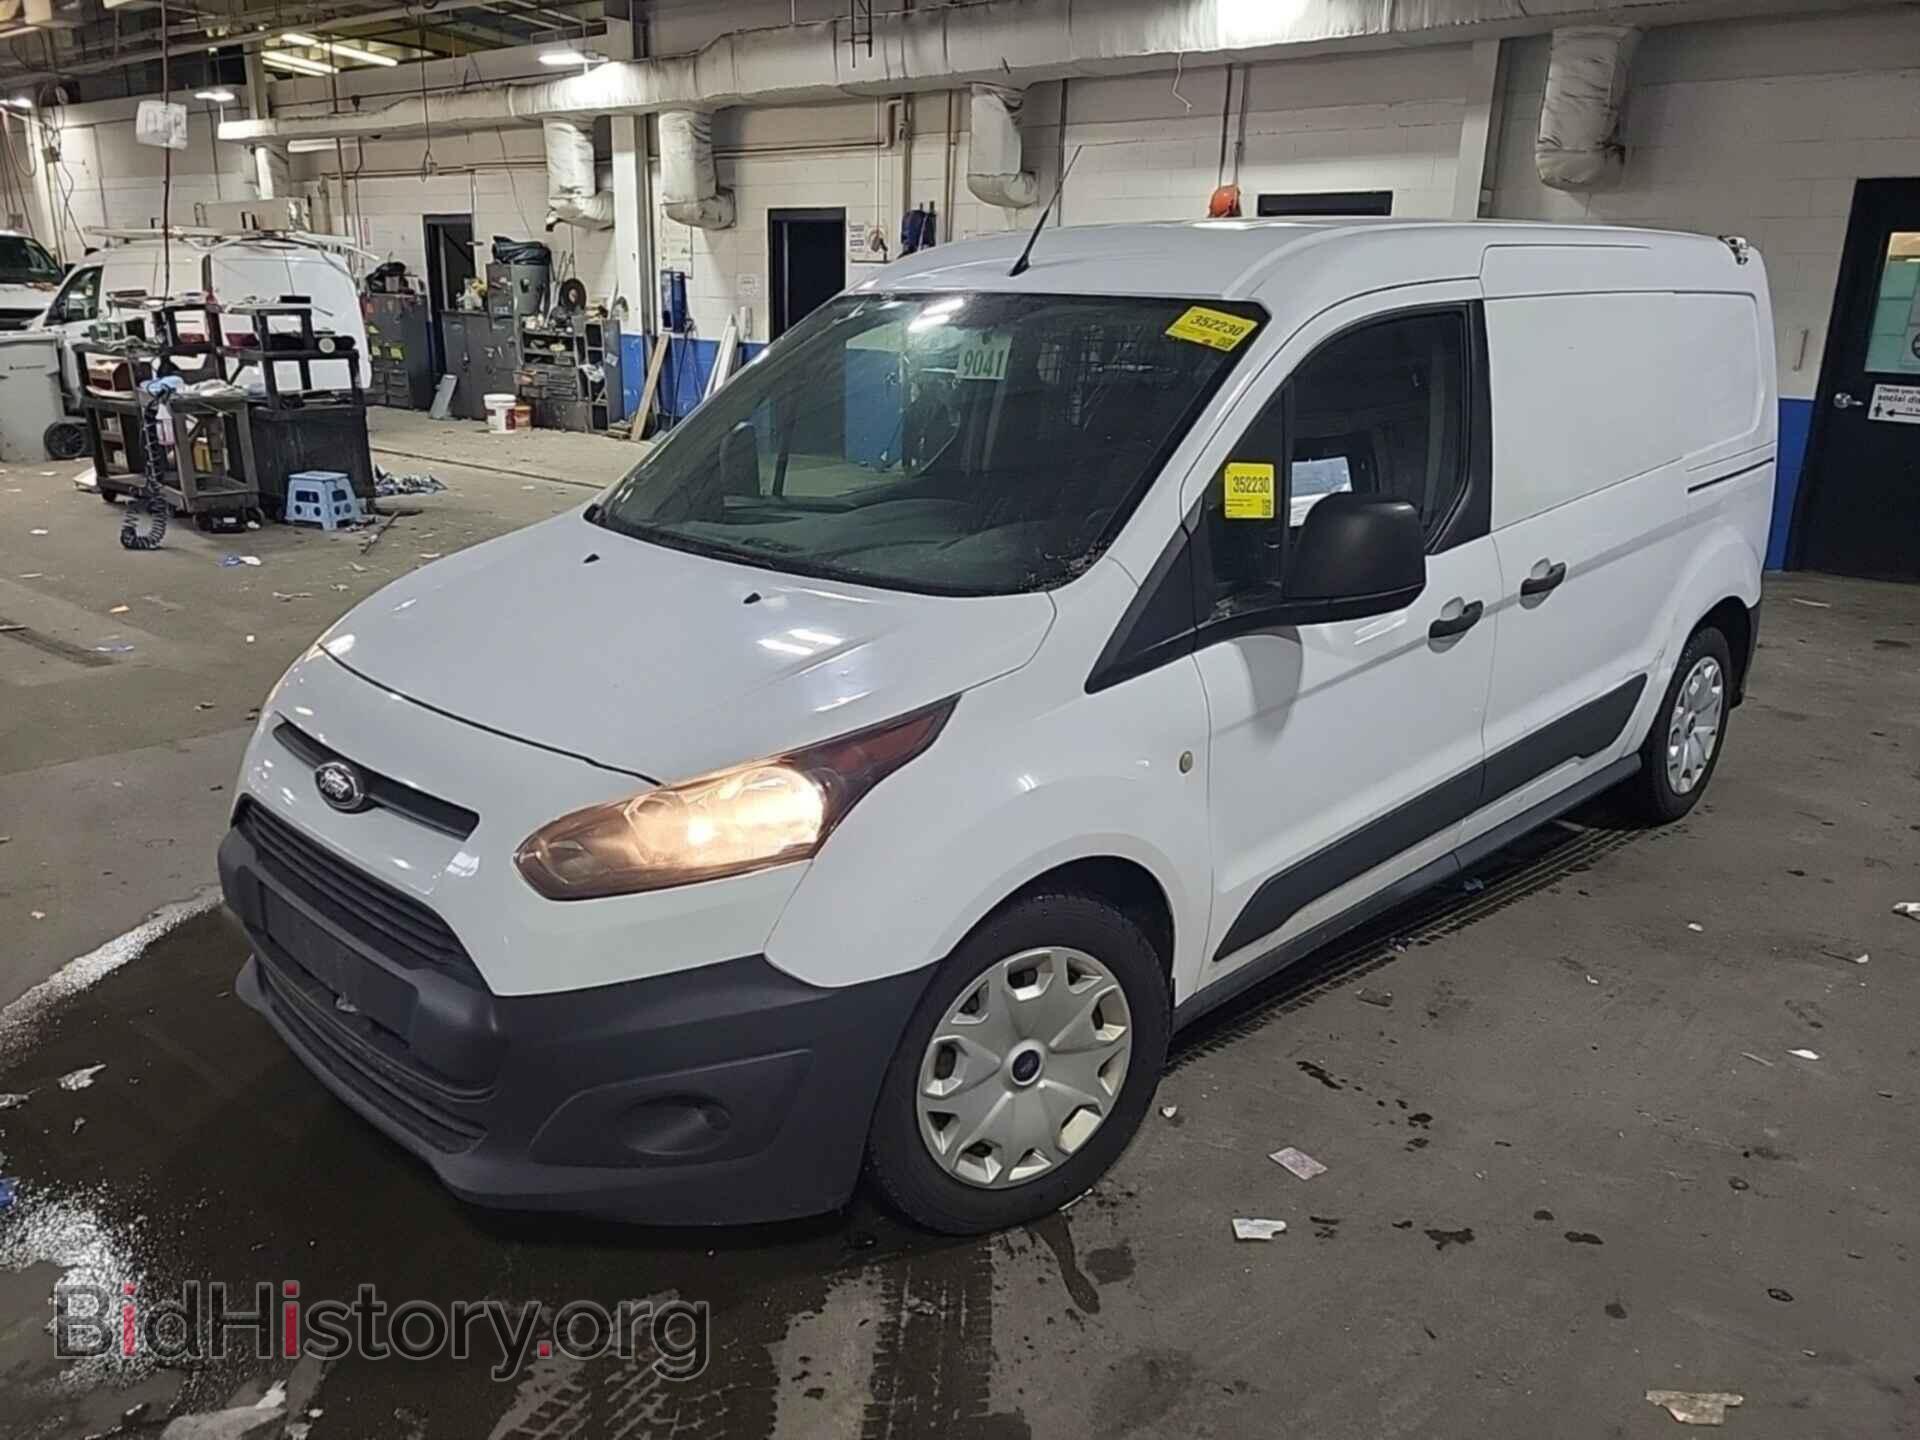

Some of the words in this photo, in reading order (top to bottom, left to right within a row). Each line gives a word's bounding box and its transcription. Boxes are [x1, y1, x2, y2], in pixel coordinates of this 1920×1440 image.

[1189, 315, 1245, 337] 352230
[963, 350, 1004, 377] 9041
[1232, 476, 1271, 493] 352230
